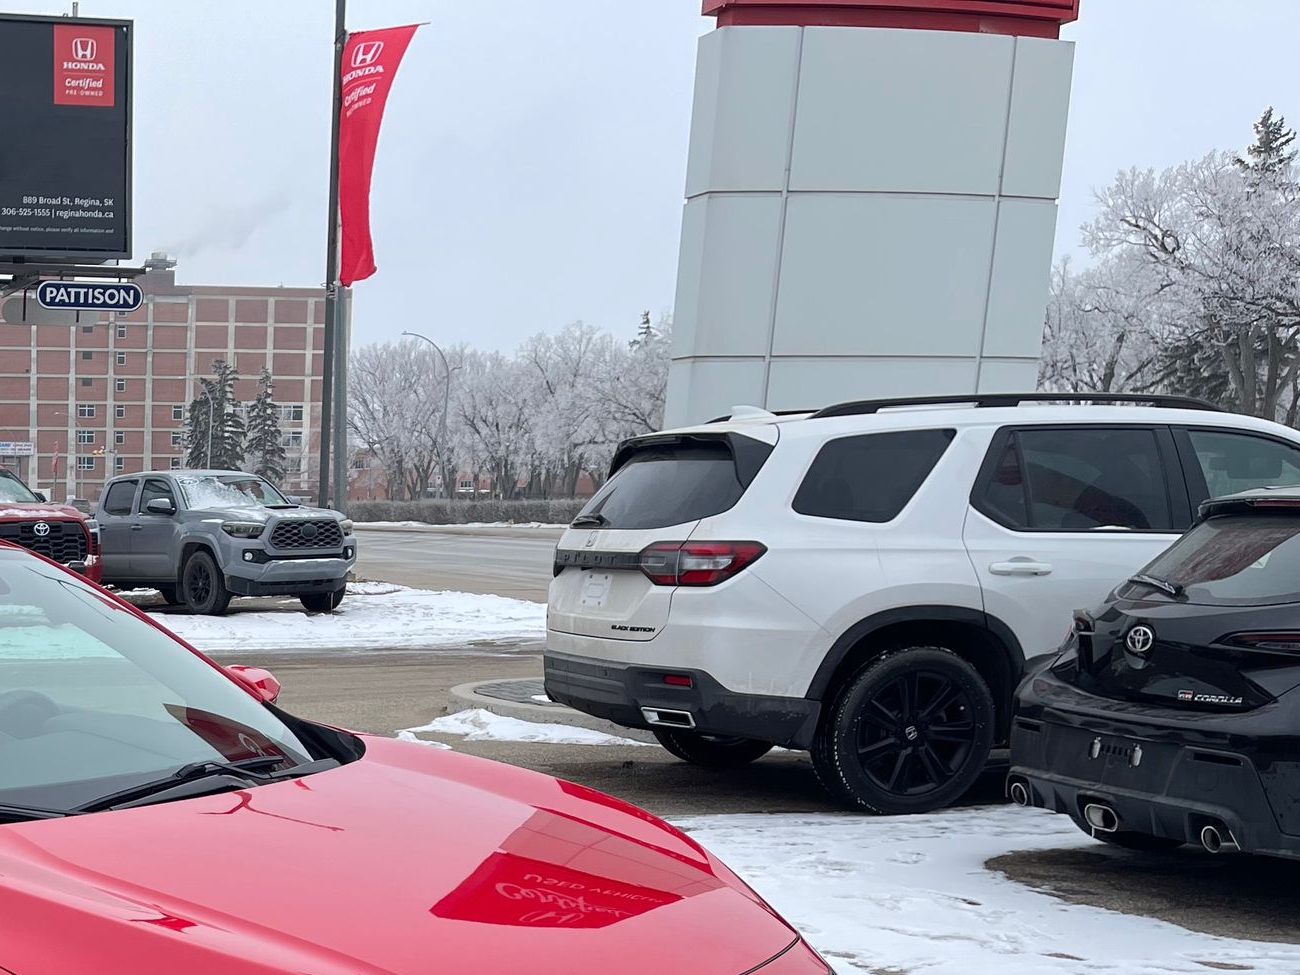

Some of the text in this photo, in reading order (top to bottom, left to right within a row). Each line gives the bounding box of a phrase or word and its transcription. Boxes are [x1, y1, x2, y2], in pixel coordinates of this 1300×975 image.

[62, 61, 105, 71] HONDA
[342, 65, 384, 85] HONDA
[65, 78, 103, 90] Certified
[22, 195, 114, 208] 889 Broad St, Regina, SK
[1, 207, 50, 217] 306-525-1555
[56, 209, 114, 219] reginahonda.ca
[45, 286, 134, 305] PATTISON
[1194, 694, 1243, 704] COROLLA
